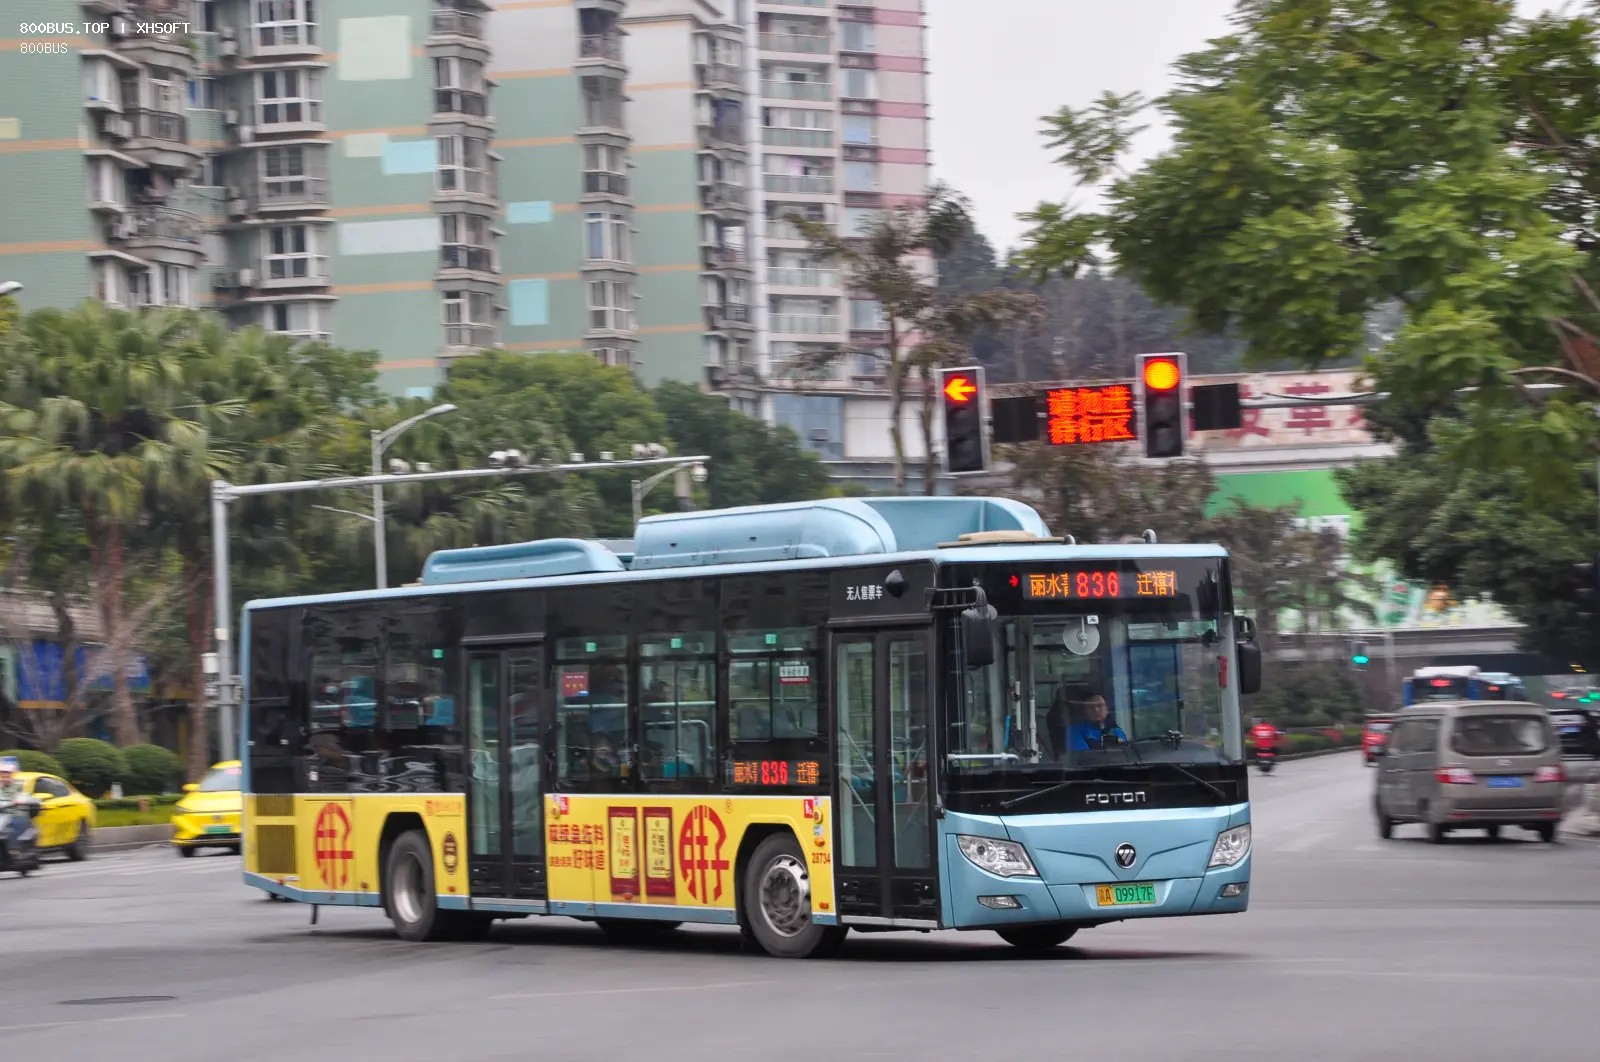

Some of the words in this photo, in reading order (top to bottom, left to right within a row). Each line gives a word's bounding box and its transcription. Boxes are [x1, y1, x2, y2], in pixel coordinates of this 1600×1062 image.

[846, 584, 883, 601] 无人售票车
[1076, 571, 1119, 598] 836
[761, 760, 789, 785] 836
[1085, 791, 1146, 805] FOTON
[812, 852, 831, 864] 28734
[1115, 886, 1153, 902] 09917F
